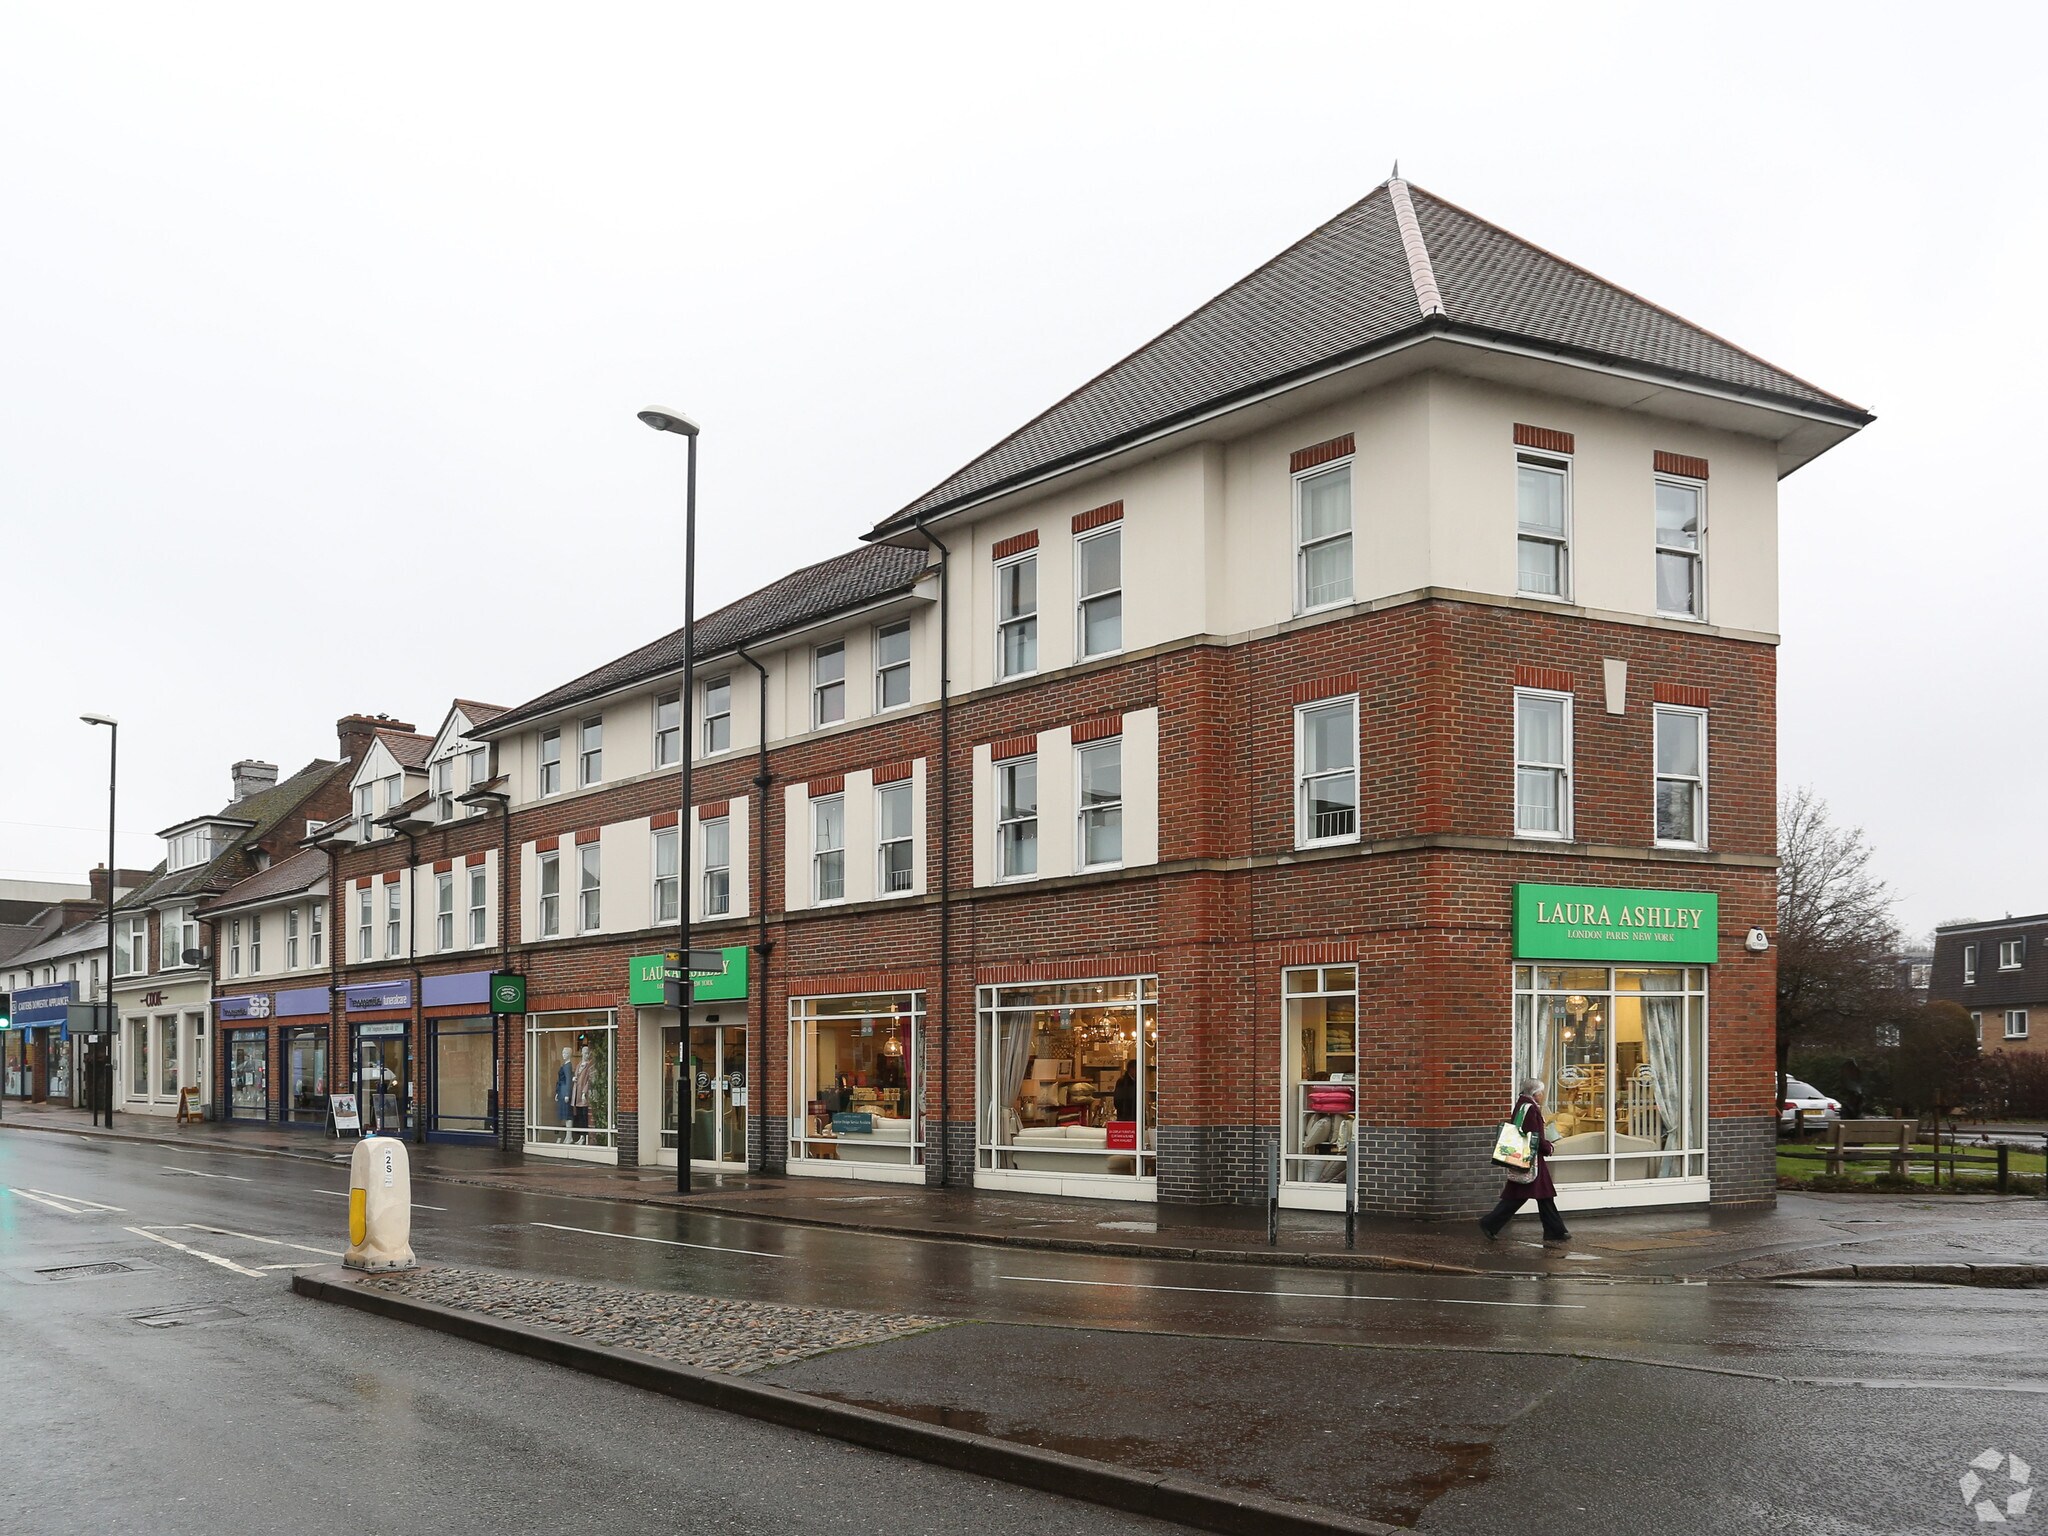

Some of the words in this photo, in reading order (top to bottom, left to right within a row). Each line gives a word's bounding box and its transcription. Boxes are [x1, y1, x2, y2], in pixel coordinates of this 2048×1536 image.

[1537, 902, 1612, 926] LAURA
[1618, 905, 1703, 929] ASHLEY
[1567, 929, 1602, 940] LONDON
[1605, 931, 1629, 941] PARIS
[1632, 932, 1651, 942] NEW
[1653, 932, 1675, 943] YORK
[386, 1156, 391, 1164] 2
[386, 1165, 392, 1173] S
